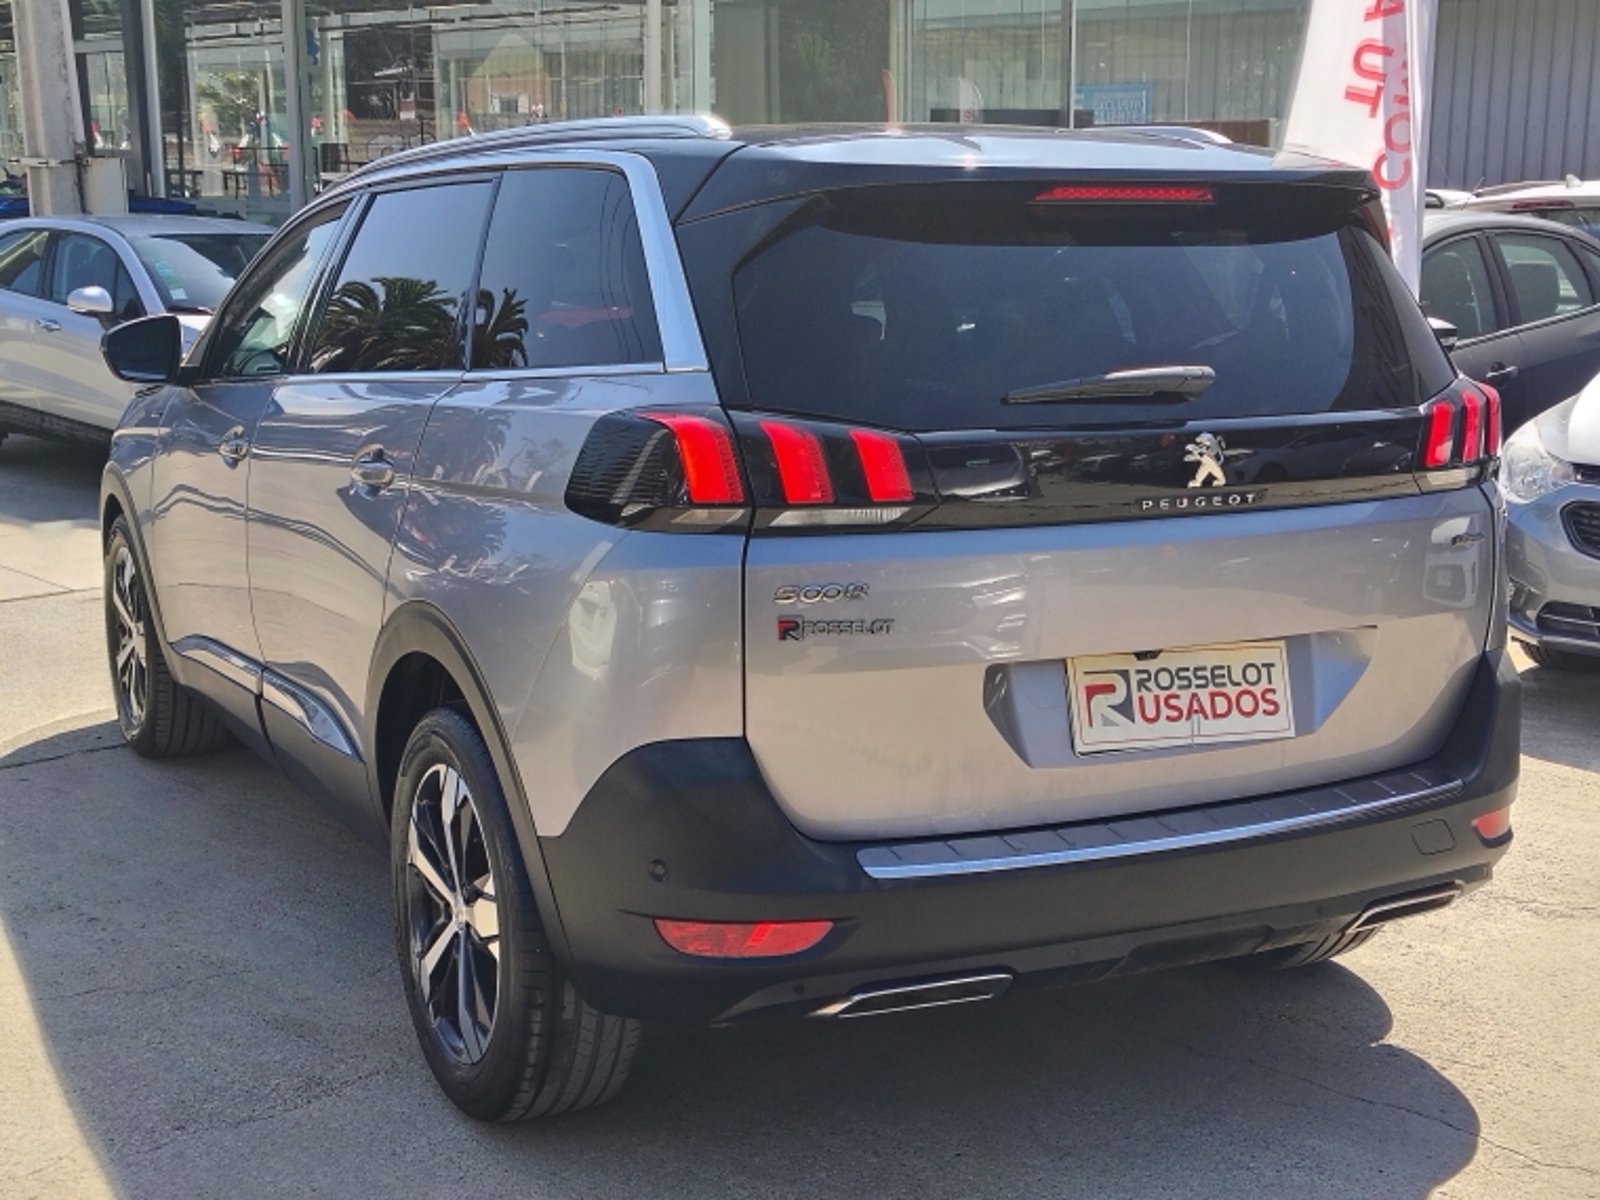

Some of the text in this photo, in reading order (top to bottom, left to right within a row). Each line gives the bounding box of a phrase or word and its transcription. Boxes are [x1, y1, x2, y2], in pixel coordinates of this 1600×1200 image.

[1142, 493, 1256, 511] PEUGEOT
[1135, 662, 1276, 692] ROSSELOT
[1138, 687, 1281, 725] USADOS
